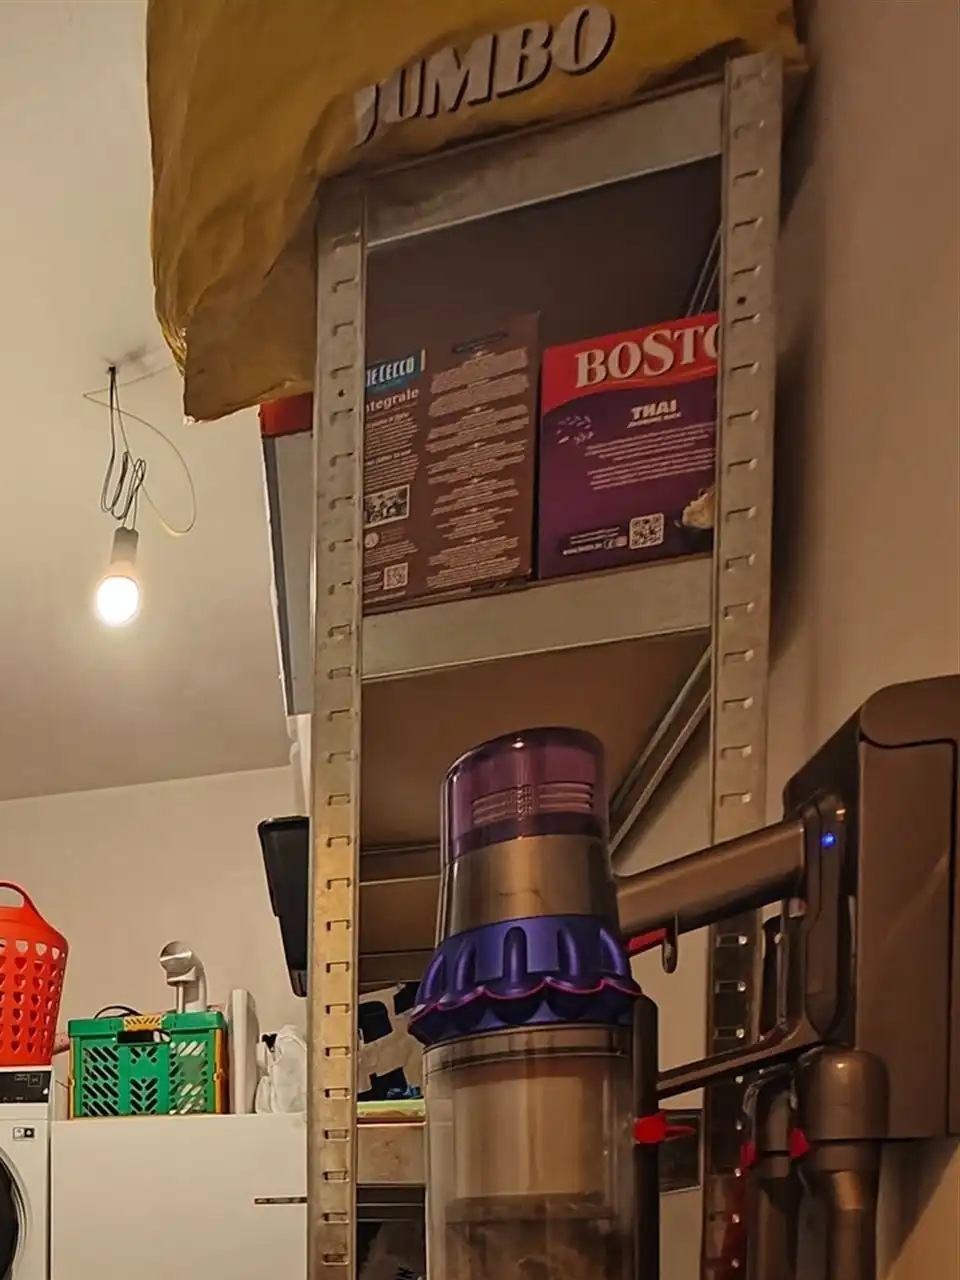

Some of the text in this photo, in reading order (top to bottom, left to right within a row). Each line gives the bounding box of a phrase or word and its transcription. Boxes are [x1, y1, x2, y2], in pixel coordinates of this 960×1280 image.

[352, 3, 617, 148] JUMBO
[366, 387, 420, 413] ntegrale
[630, 400, 678, 421] THAI
